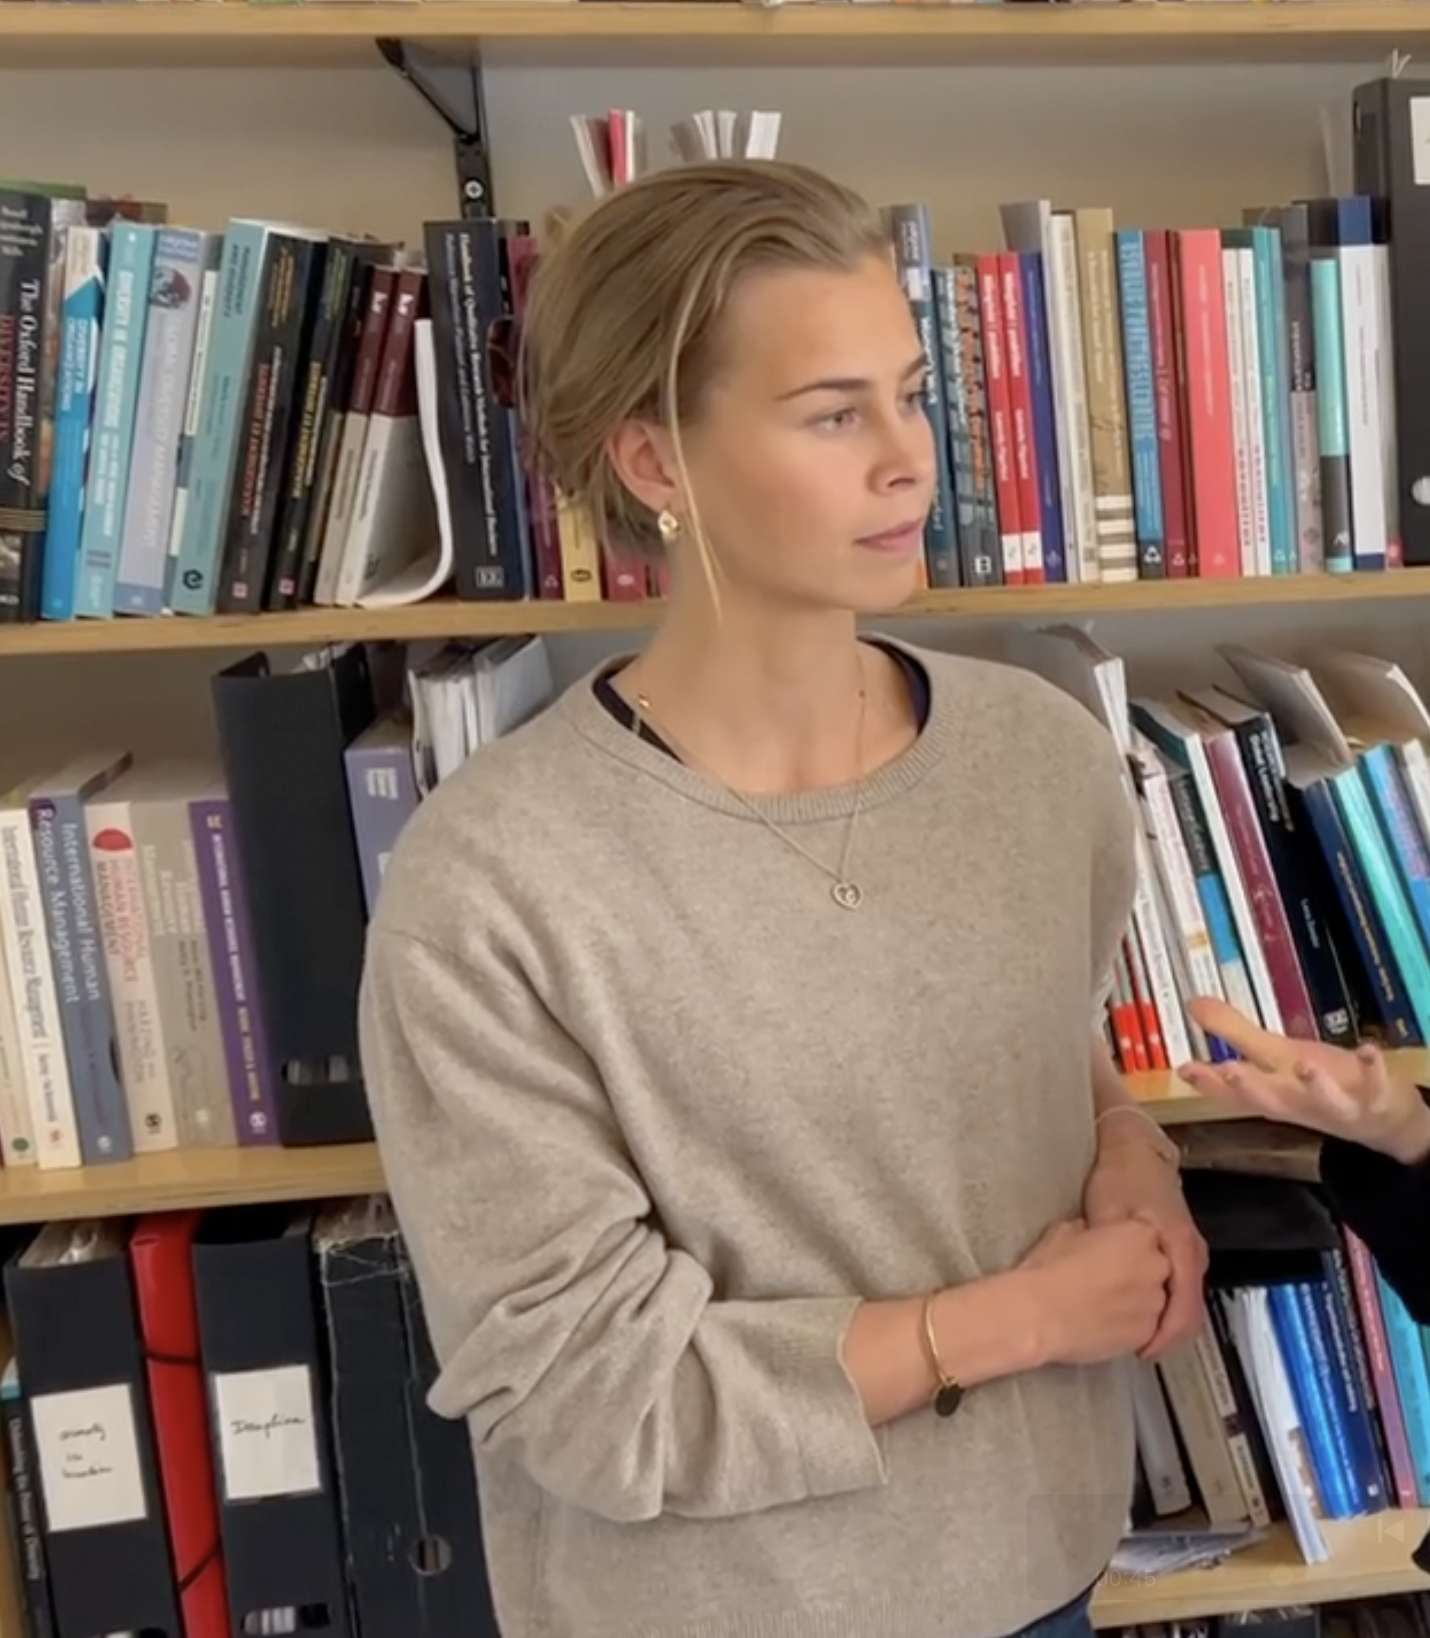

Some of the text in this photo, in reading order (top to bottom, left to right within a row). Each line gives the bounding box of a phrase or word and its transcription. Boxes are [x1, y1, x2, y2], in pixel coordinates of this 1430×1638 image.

[12, 281, 38, 484] The Oxford Handbook of
[75, 316, 88, 376] DIVERSITY
[162, 318, 181, 375] GLOBAL
[36, 807, 81, 1003] Resource Management
[63, 822, 101, 999] International Human
[96, 861, 119, 955] MANAGEMENT
[111, 859, 128, 910] HUMAN
[20, 1492, 34, 1521] Power
